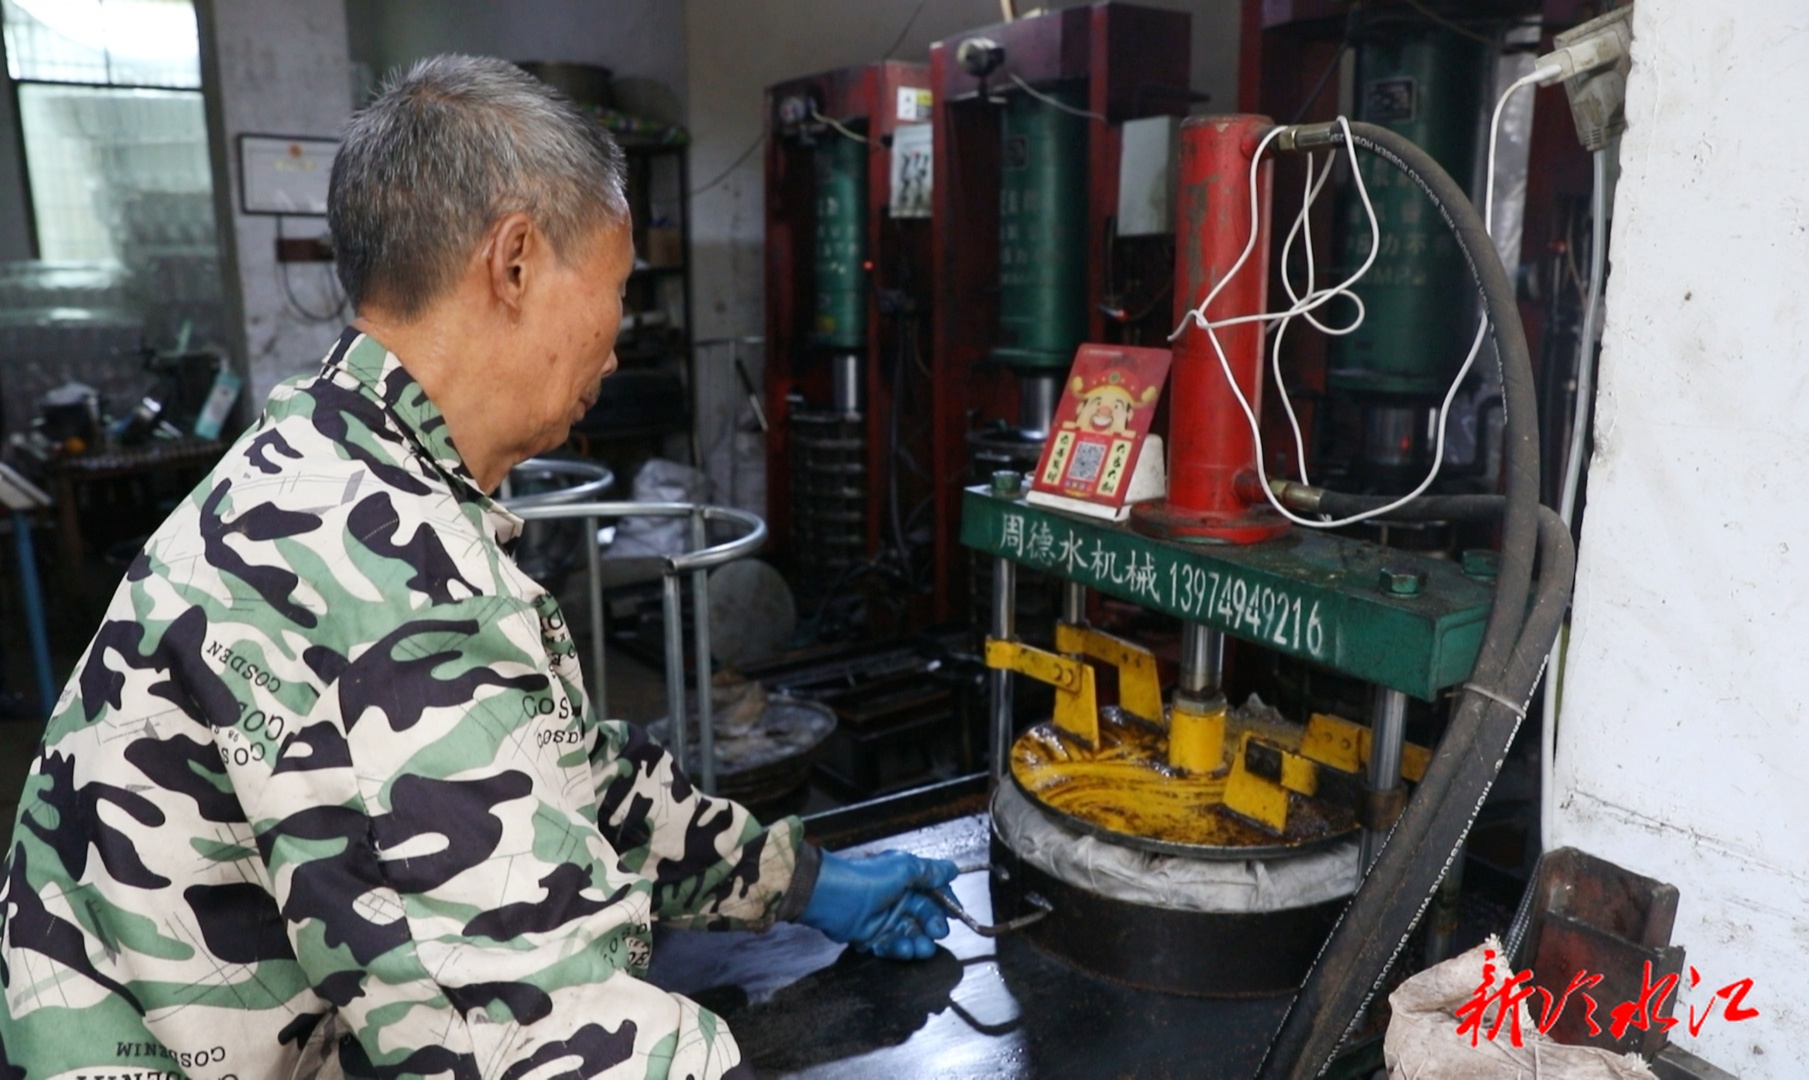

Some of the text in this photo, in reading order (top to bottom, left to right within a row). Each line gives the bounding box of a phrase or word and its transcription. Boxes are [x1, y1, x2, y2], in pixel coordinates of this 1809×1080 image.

[1351, 133, 1374, 150] HOS
[1000, 514, 1323, 656] 周德水机械 13974949216
[206, 641, 281, 693] COSDEN
[536, 728, 584, 748] COSD
[1471, 781, 1493, 817] HIGH
[1429, 819, 1474, 894] PRESSURE
[1407, 897, 1432, 931] WIRE
[1373, 931, 1410, 990] BRAIDED
